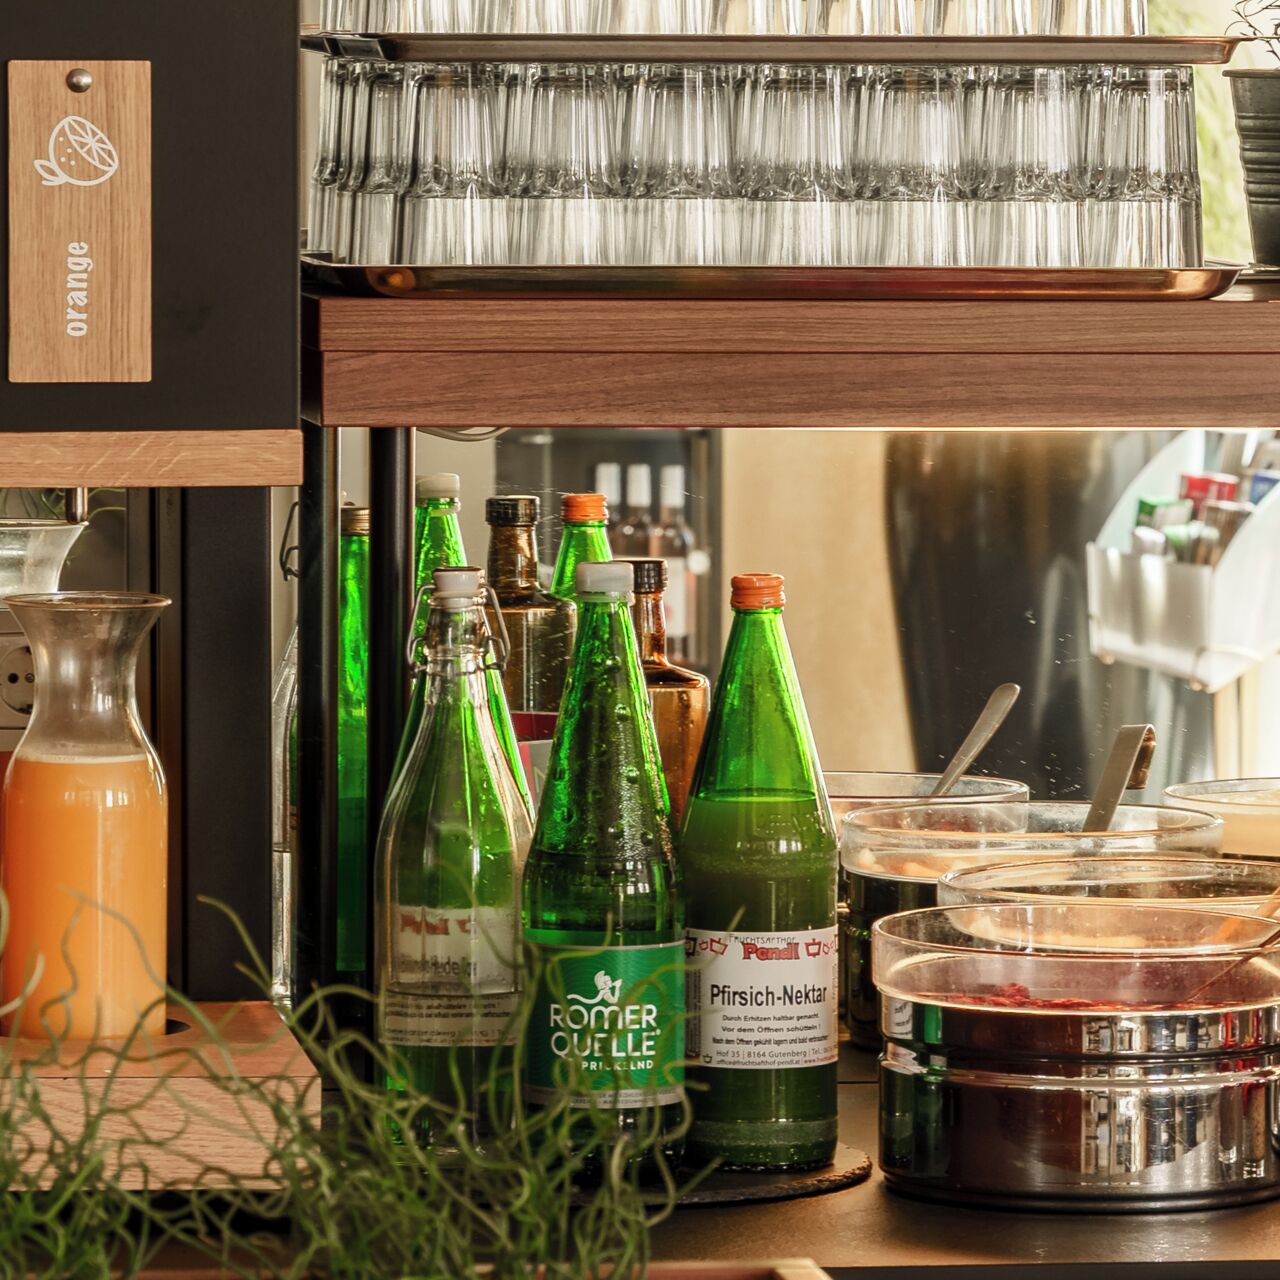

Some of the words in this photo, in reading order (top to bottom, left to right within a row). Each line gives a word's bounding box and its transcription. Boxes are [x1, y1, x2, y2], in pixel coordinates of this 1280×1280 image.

[67, 241, 94, 337] orange
[742, 941, 801, 961] Pendl
[710, 983, 827, 1008] Pfirsich-Nektar
[731, 1050, 740, 1058] 35
[768, 1050, 807, 1059] Gutenberg
